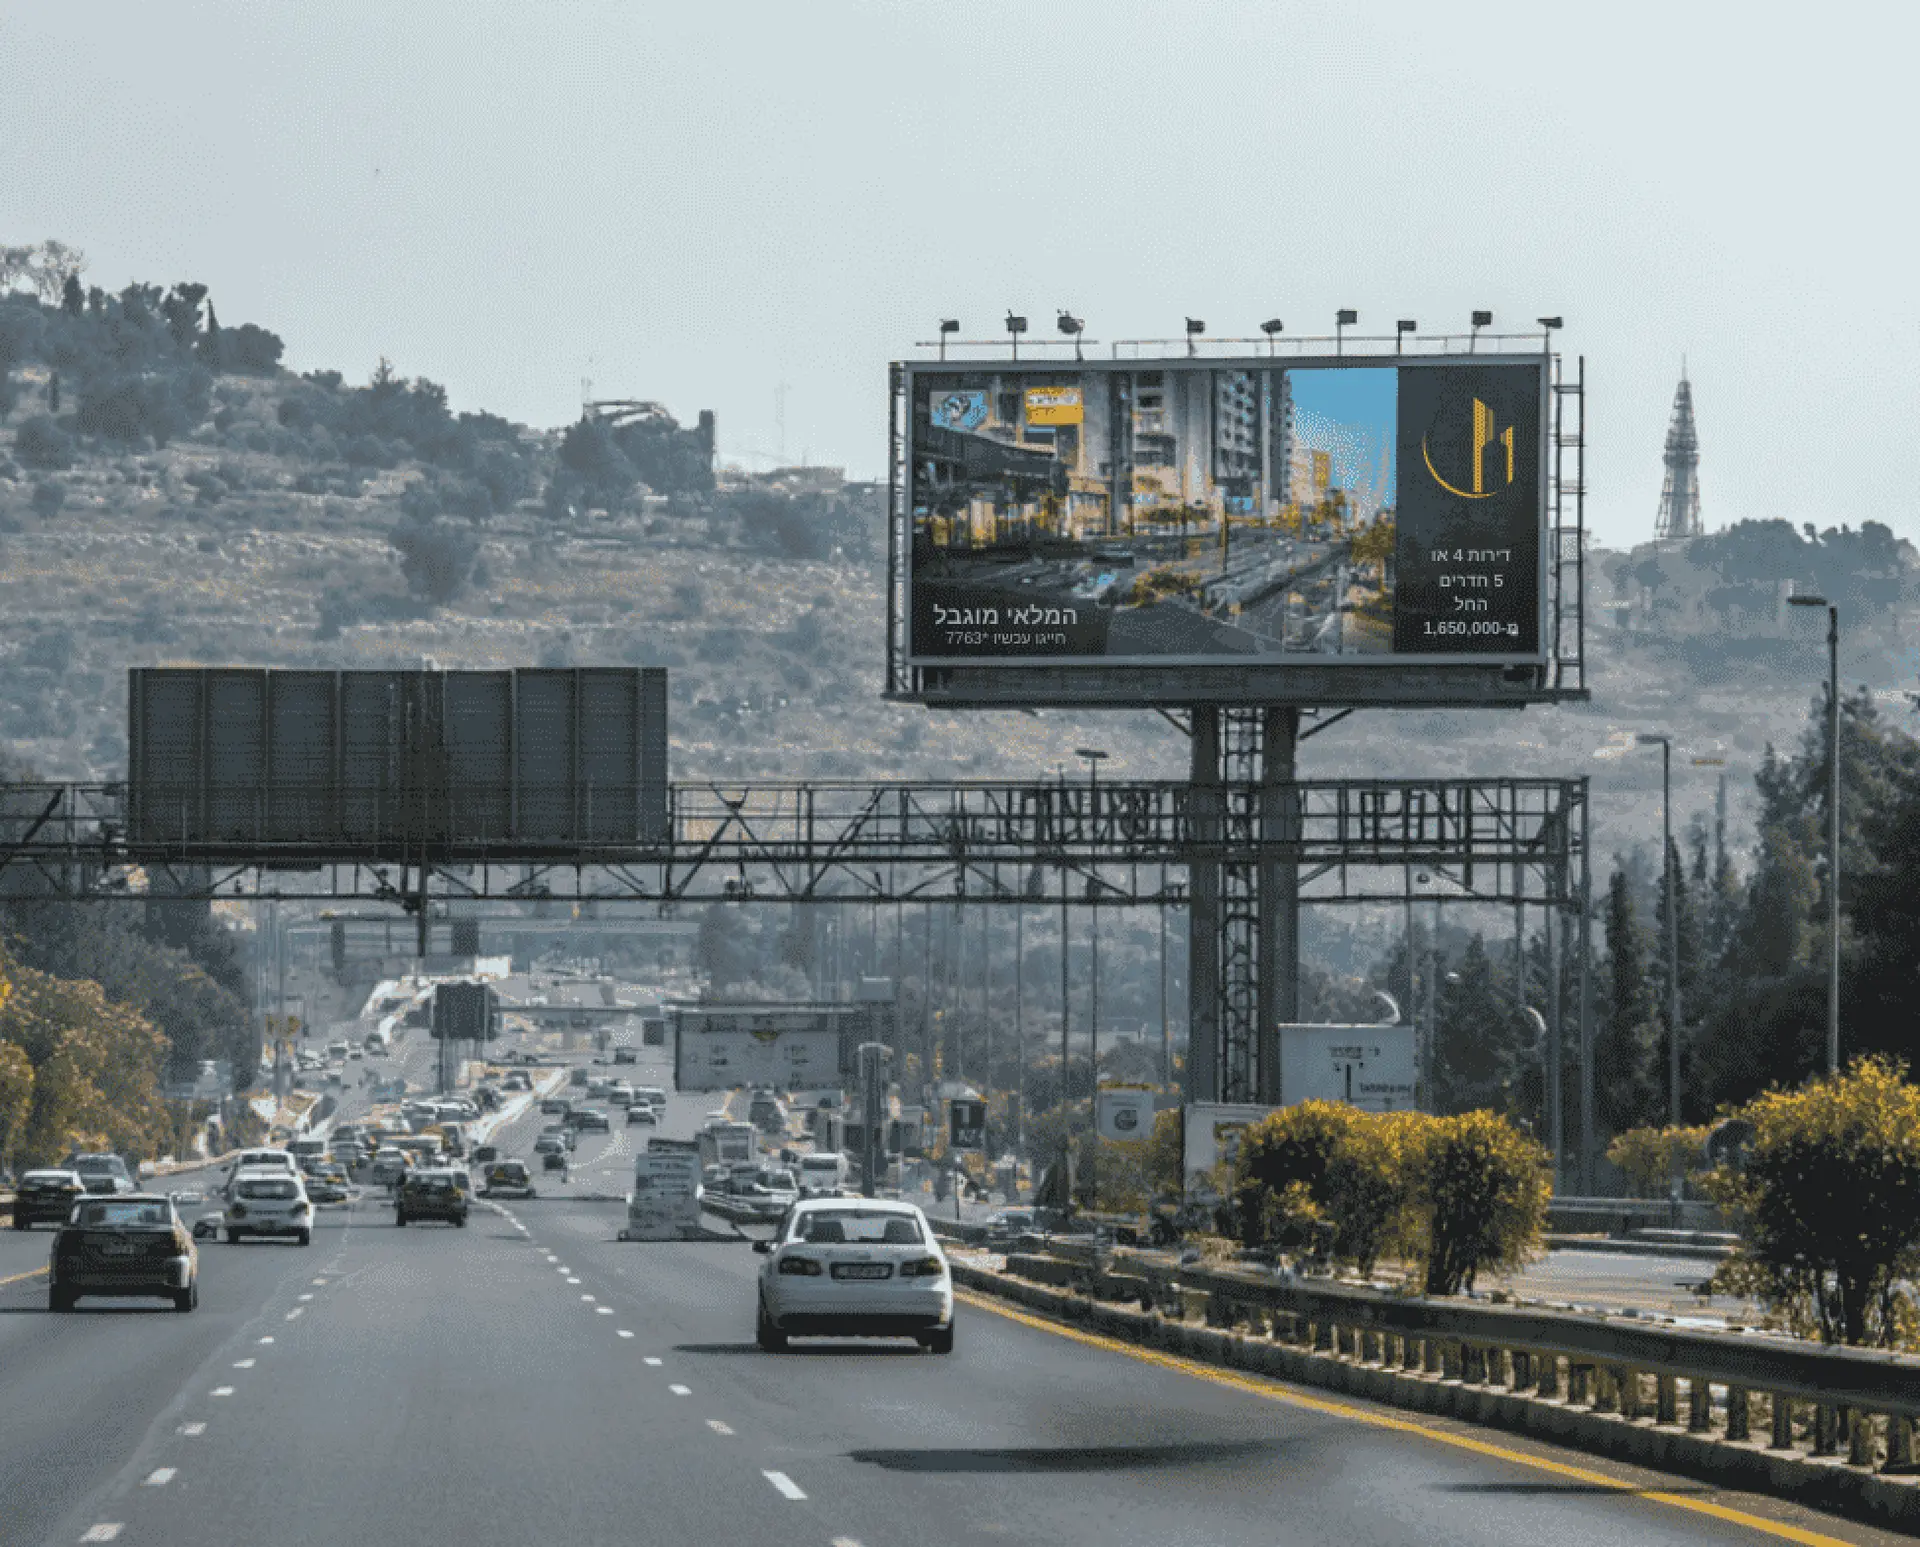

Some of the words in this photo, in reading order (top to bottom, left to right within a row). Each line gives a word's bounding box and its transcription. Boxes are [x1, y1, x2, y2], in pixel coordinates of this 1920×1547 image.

[1431, 550, 1448, 561] או
[1453, 549, 1463, 561] 4
[1468, 549, 1511, 561] דירות
[1439, 575, 1488, 587] חדרים
[1494, 574, 1504, 587] 5
[1454, 595, 1488, 611] החל
[932, 603, 1000, 625] מוגבל
[1007, 603, 1078, 625] המלאי
[993, 633, 1031, 645] עכשיו
[1035, 633, 1066, 645] חייגו
